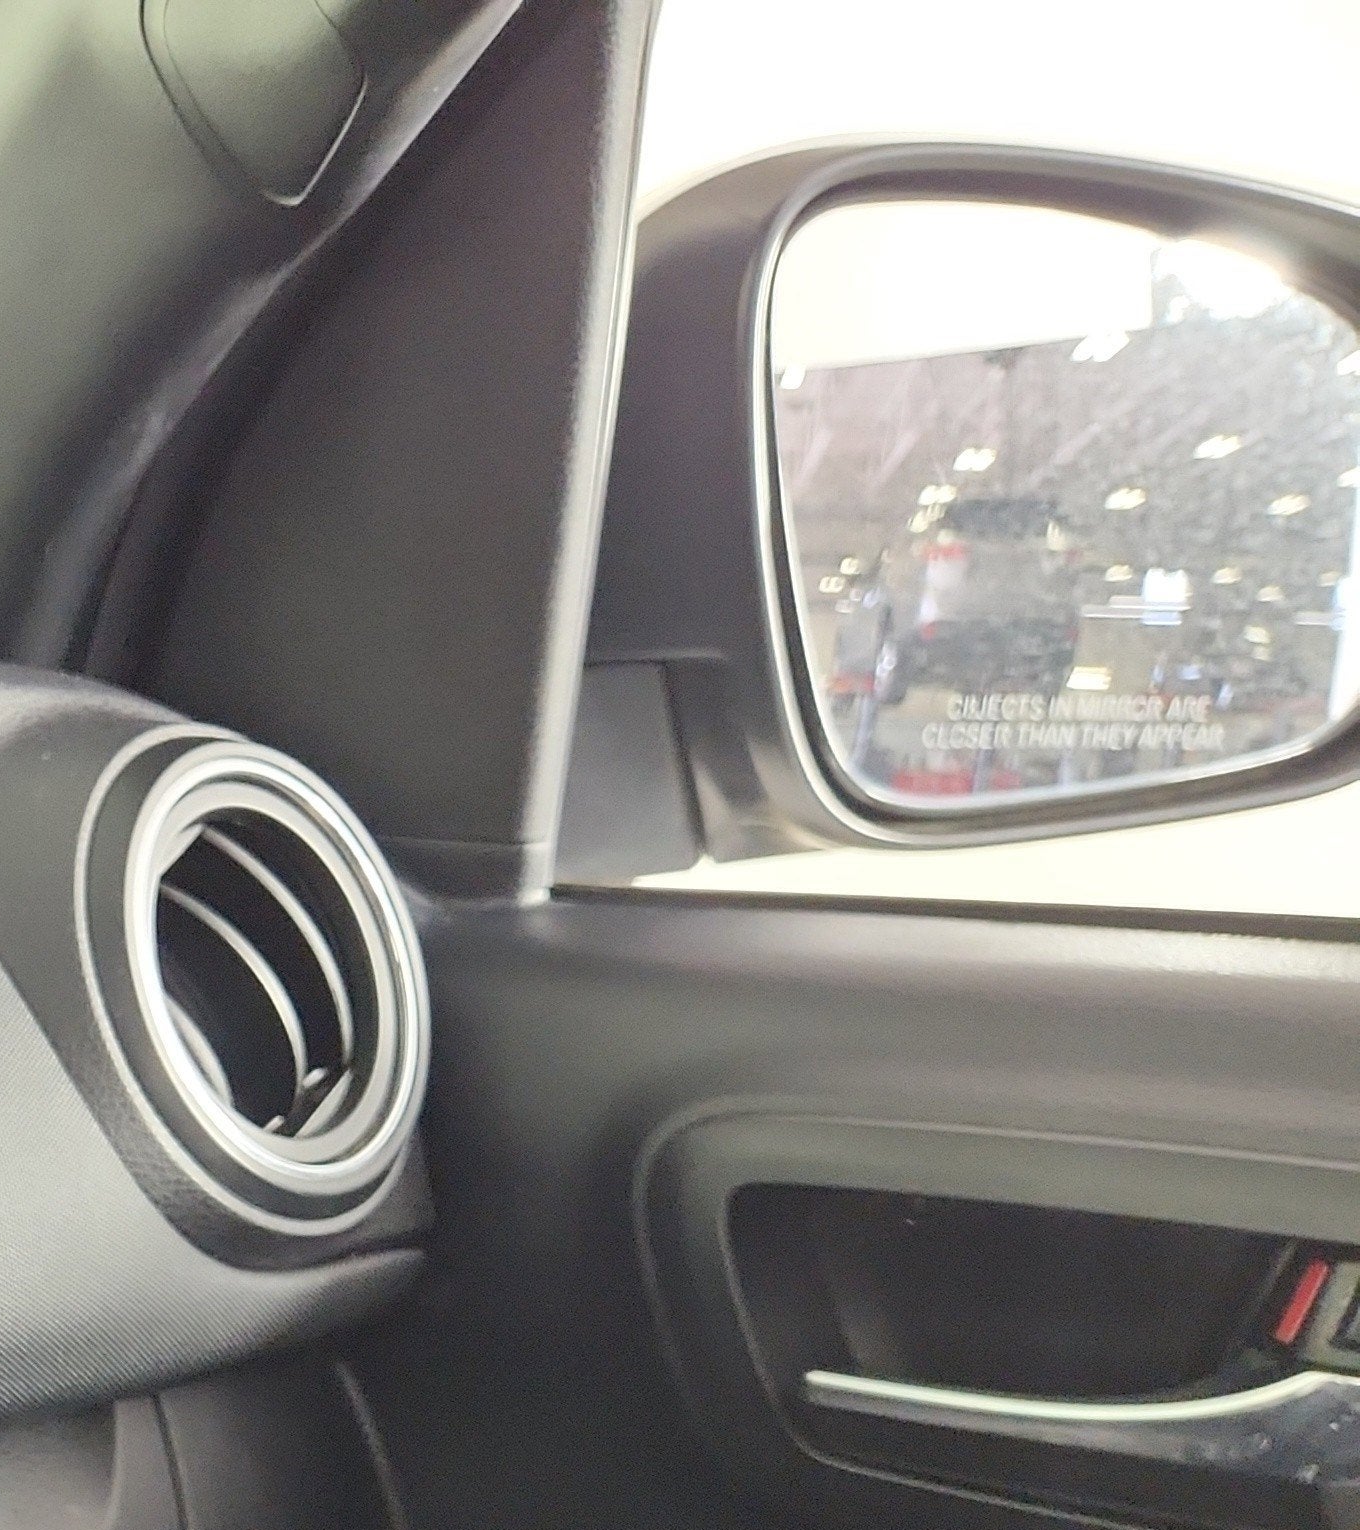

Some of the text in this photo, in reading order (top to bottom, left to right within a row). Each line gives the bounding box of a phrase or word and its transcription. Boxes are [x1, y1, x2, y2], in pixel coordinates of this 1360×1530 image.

[946, 694, 1213, 722] OBJECTS IN MIRROR ARE
[921, 722, 1226, 751] CLOSER THAN THEY APPEAR
